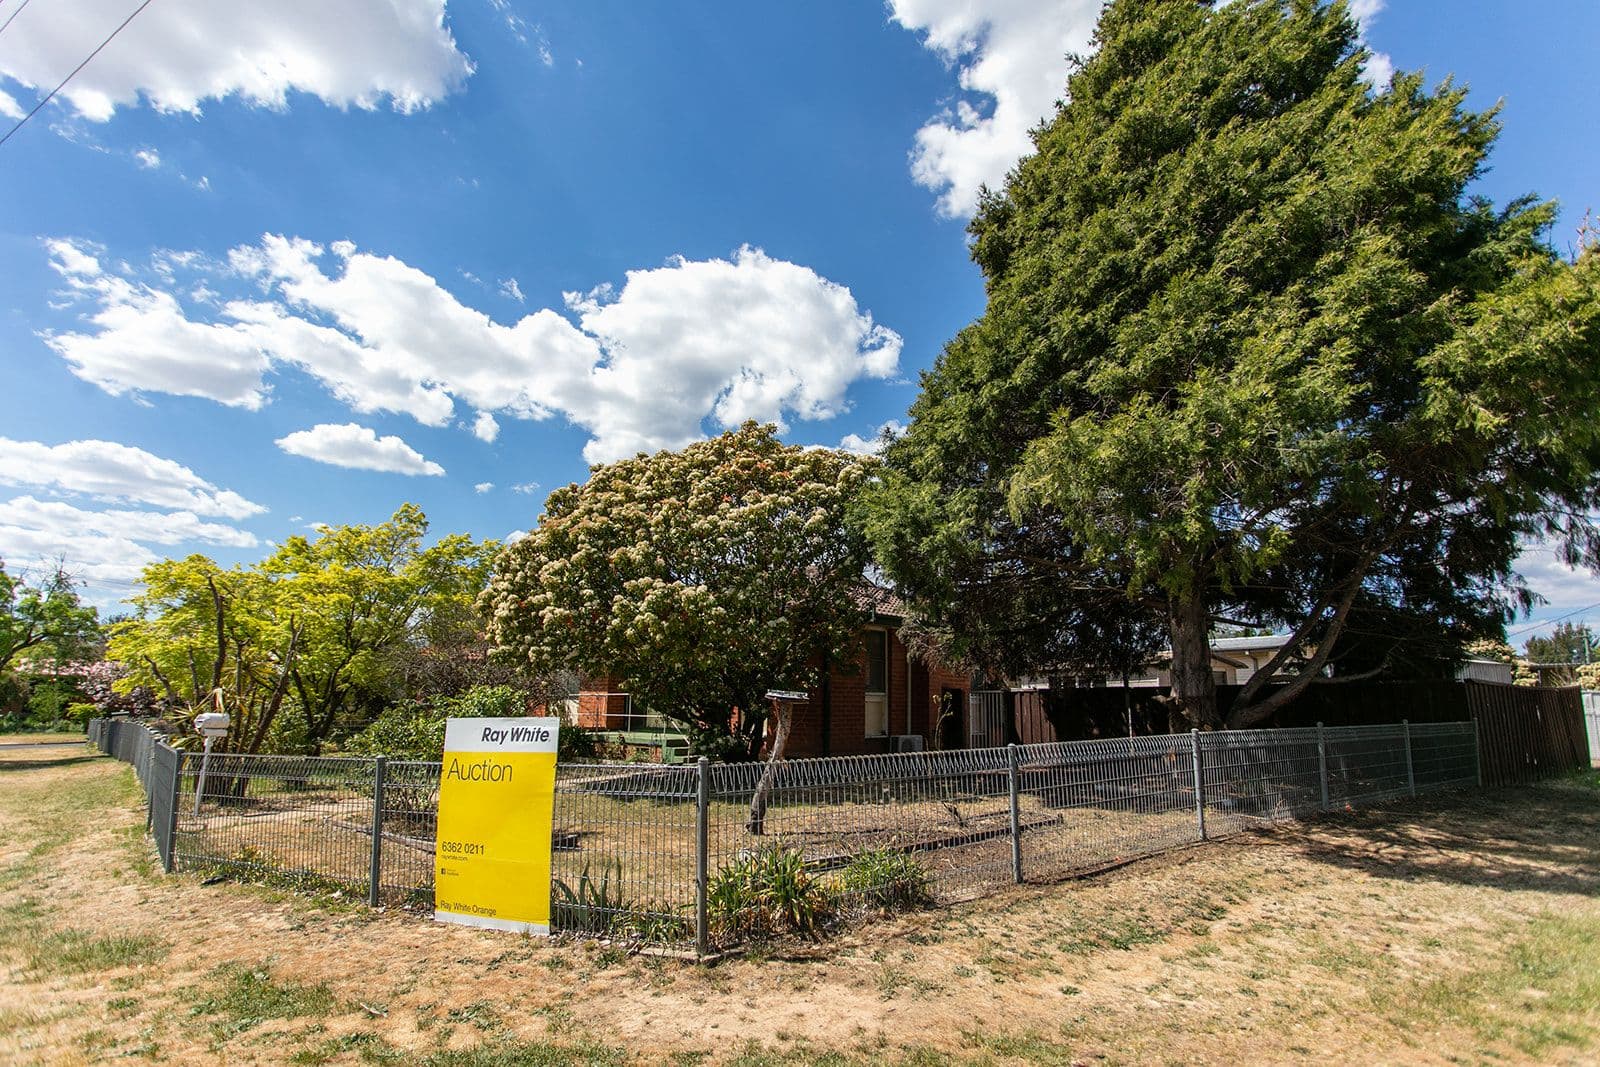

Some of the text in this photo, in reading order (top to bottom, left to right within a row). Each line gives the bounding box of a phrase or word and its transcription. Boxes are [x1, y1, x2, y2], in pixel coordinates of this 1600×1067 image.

[481, 727, 550, 745] Ray White
[447, 758, 513, 782] Auction
[442, 841, 484, 855] 6362 0211
[440, 900, 497, 916] Ray White Orange
